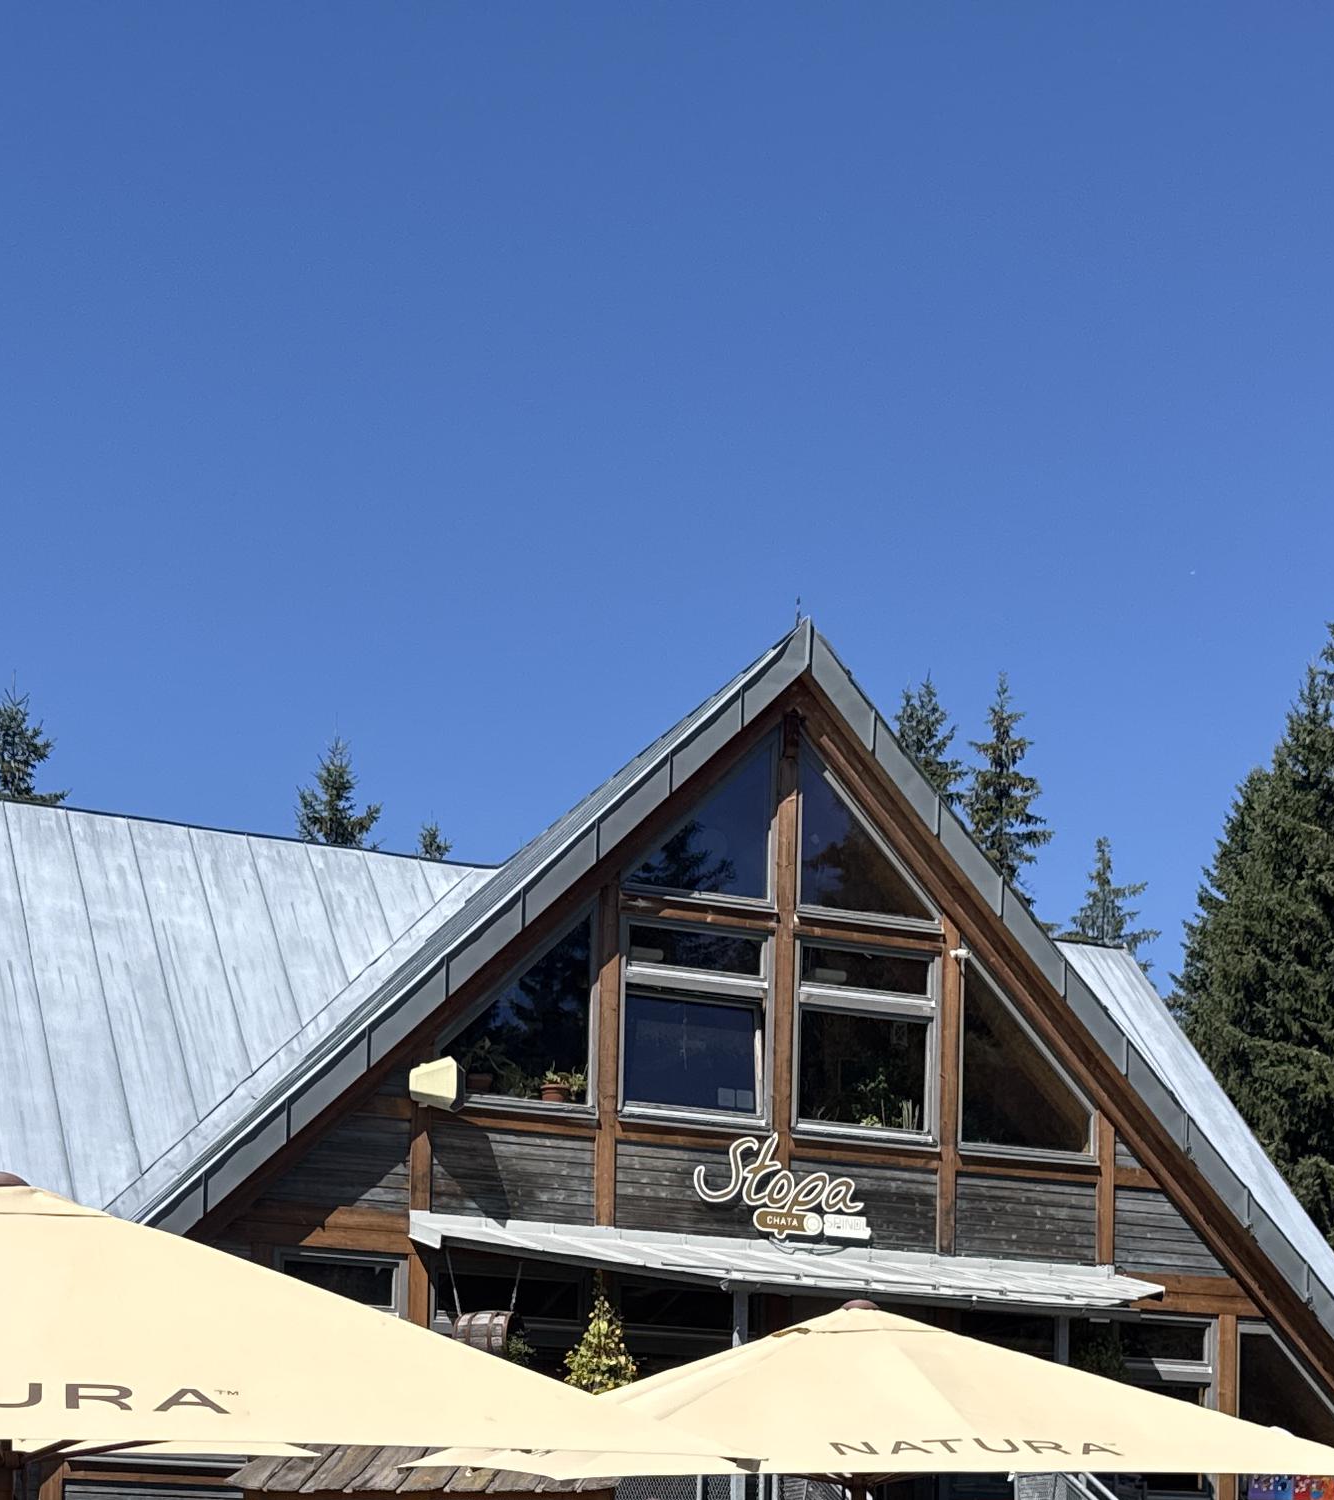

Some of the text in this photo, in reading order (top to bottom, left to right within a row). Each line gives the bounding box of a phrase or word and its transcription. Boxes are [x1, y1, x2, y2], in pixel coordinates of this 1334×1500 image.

[693, 1132, 865, 1214] Stopa
[766, 1215, 799, 1227] CHATA
[828, 1437, 1125, 1457] NATURA
